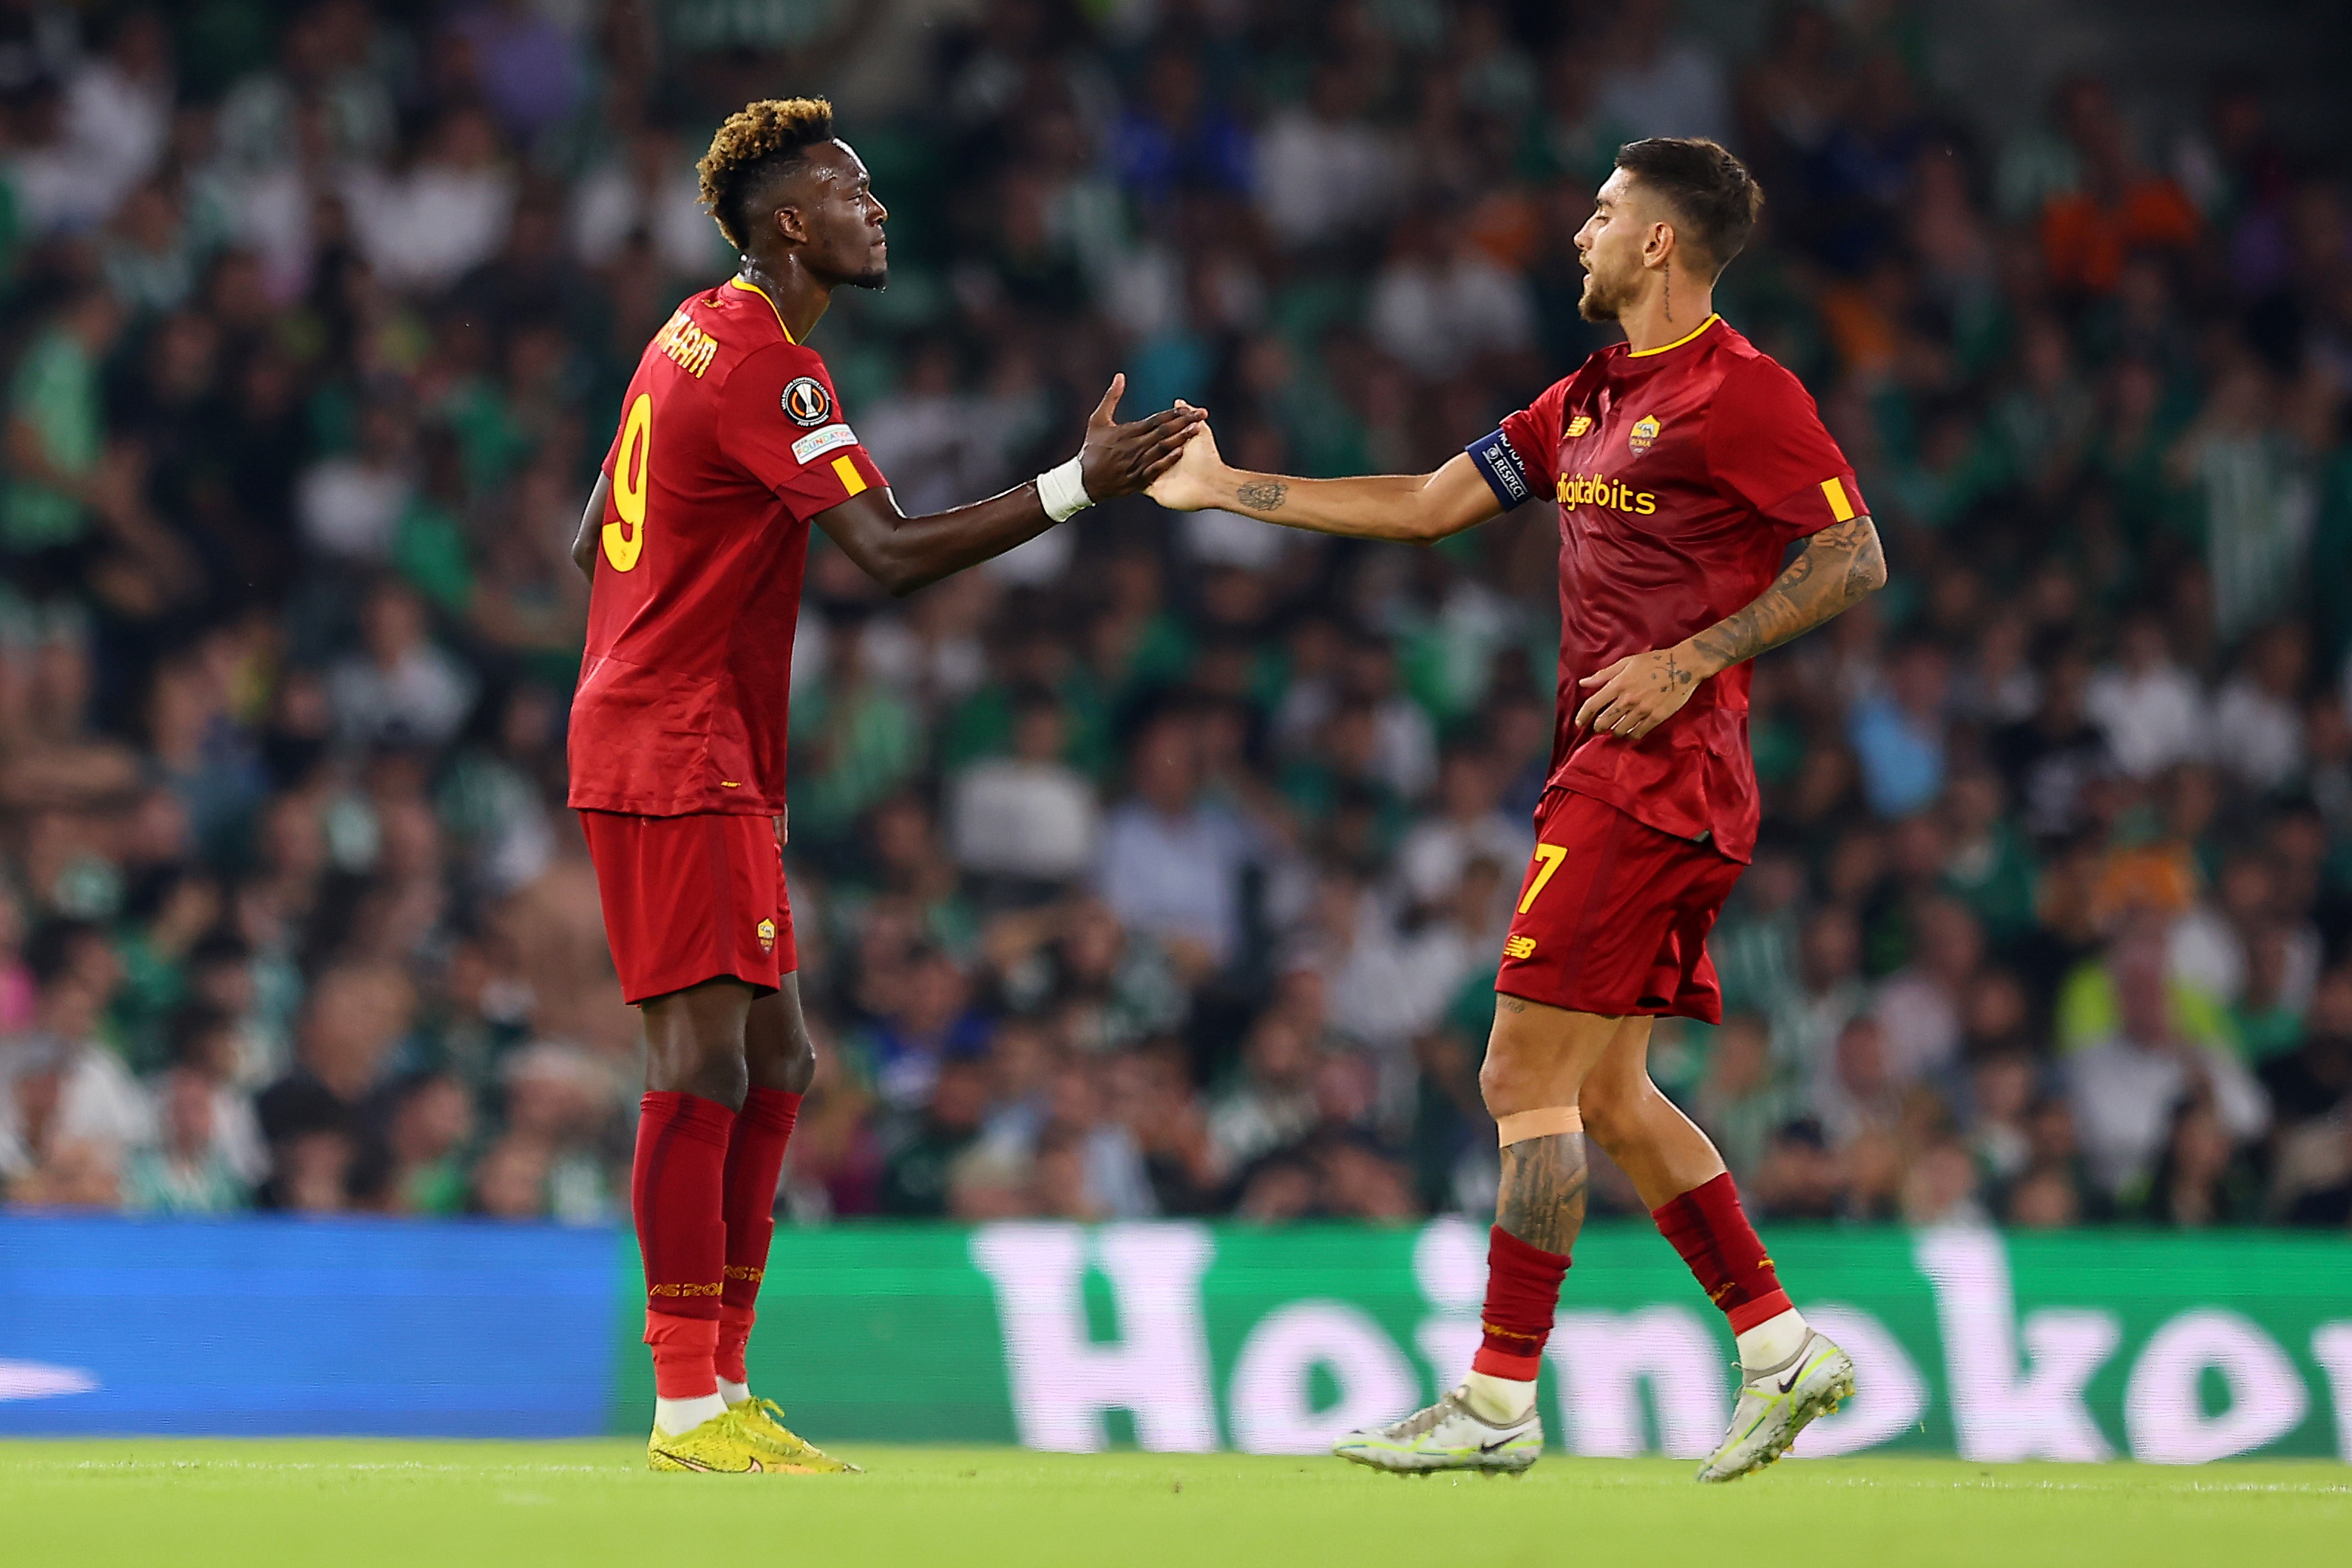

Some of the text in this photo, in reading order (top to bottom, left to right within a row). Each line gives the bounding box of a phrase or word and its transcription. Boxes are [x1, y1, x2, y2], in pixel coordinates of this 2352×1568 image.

[602, 393, 652, 572] 9
[1494, 459, 1526, 498] RESPECT
[1556, 472, 1656, 515] digitalbits
[1518, 843, 1568, 914] 7
